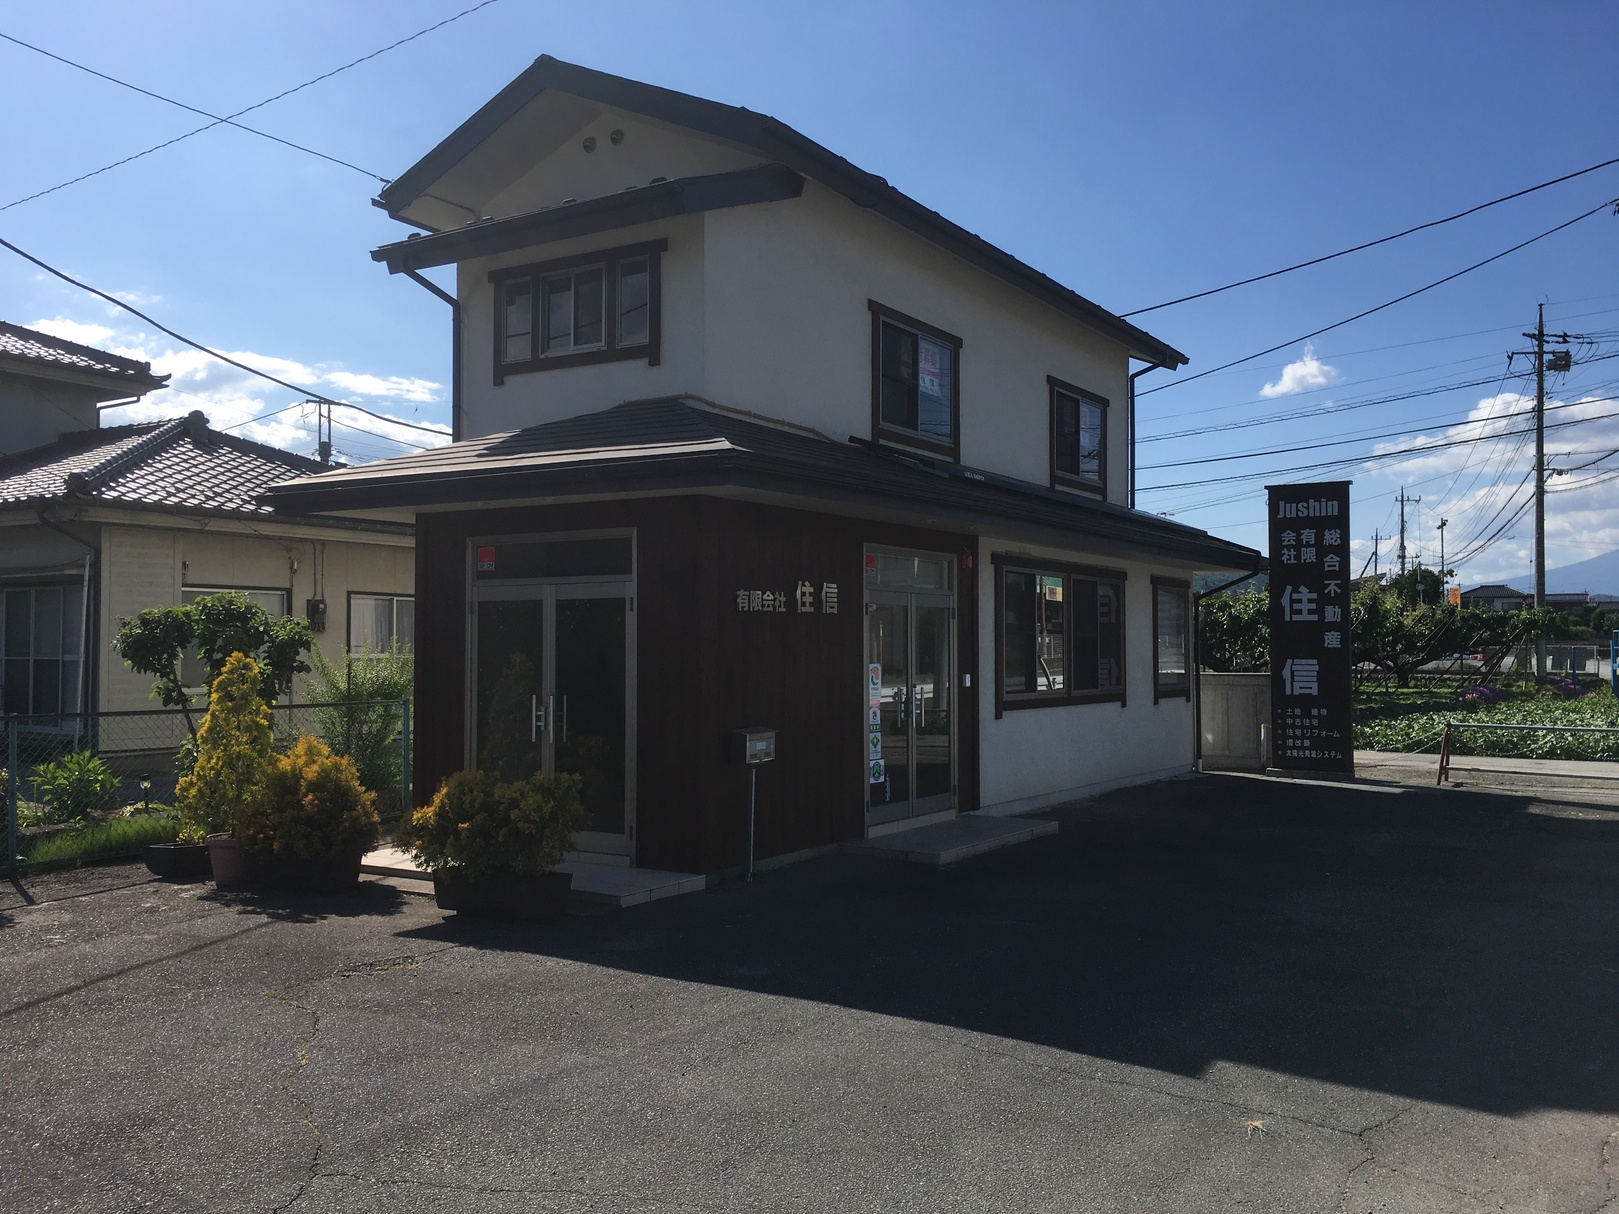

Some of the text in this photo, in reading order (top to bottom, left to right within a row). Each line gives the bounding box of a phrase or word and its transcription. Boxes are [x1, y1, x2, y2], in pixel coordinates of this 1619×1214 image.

[1277, 499, 1339, 518] Jushin
[736, 580, 838, 614] 有限会社 住信
[1323, 528, 1341, 648] 総合不動産
[1281, 585, 1319, 696] 住信
[1286, 718, 1319, 726] 中古住宅
[1286, 728, 1340, 737] 住宅リフォーム
[1286, 749, 1343, 759] 太陽光発電システム
